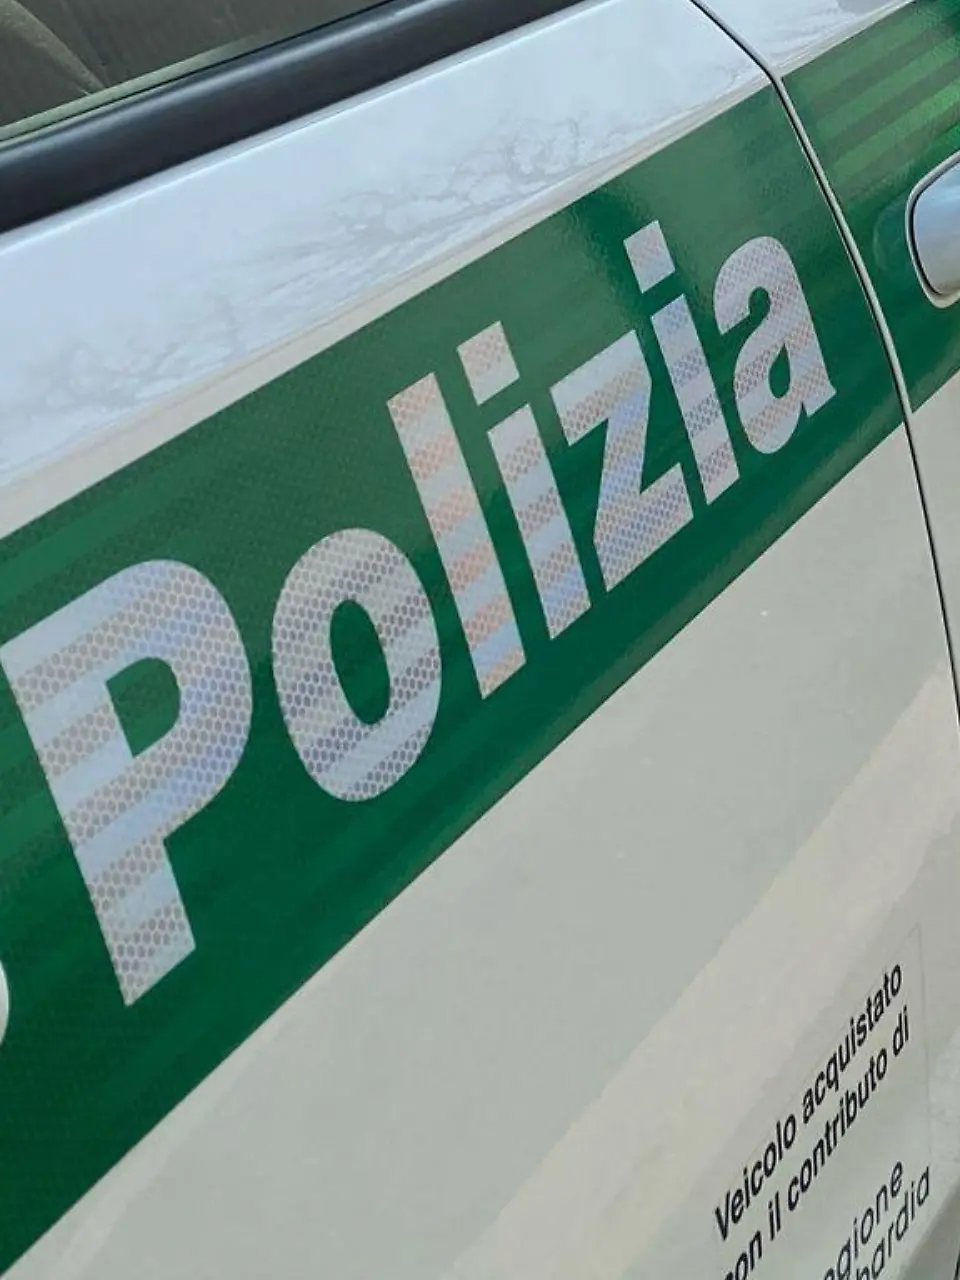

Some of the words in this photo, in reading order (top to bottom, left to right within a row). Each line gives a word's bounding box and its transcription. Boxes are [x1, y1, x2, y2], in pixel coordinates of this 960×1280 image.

[1, 220, 836, 1007] Polizia
[714, 1113, 796, 1242] Veicolo
[802, 964, 902, 1124] acquistato
[768, 1190, 782, 1242] il
[787, 1047, 888, 1212] contributo
[892, 1004, 909, 1057] di
